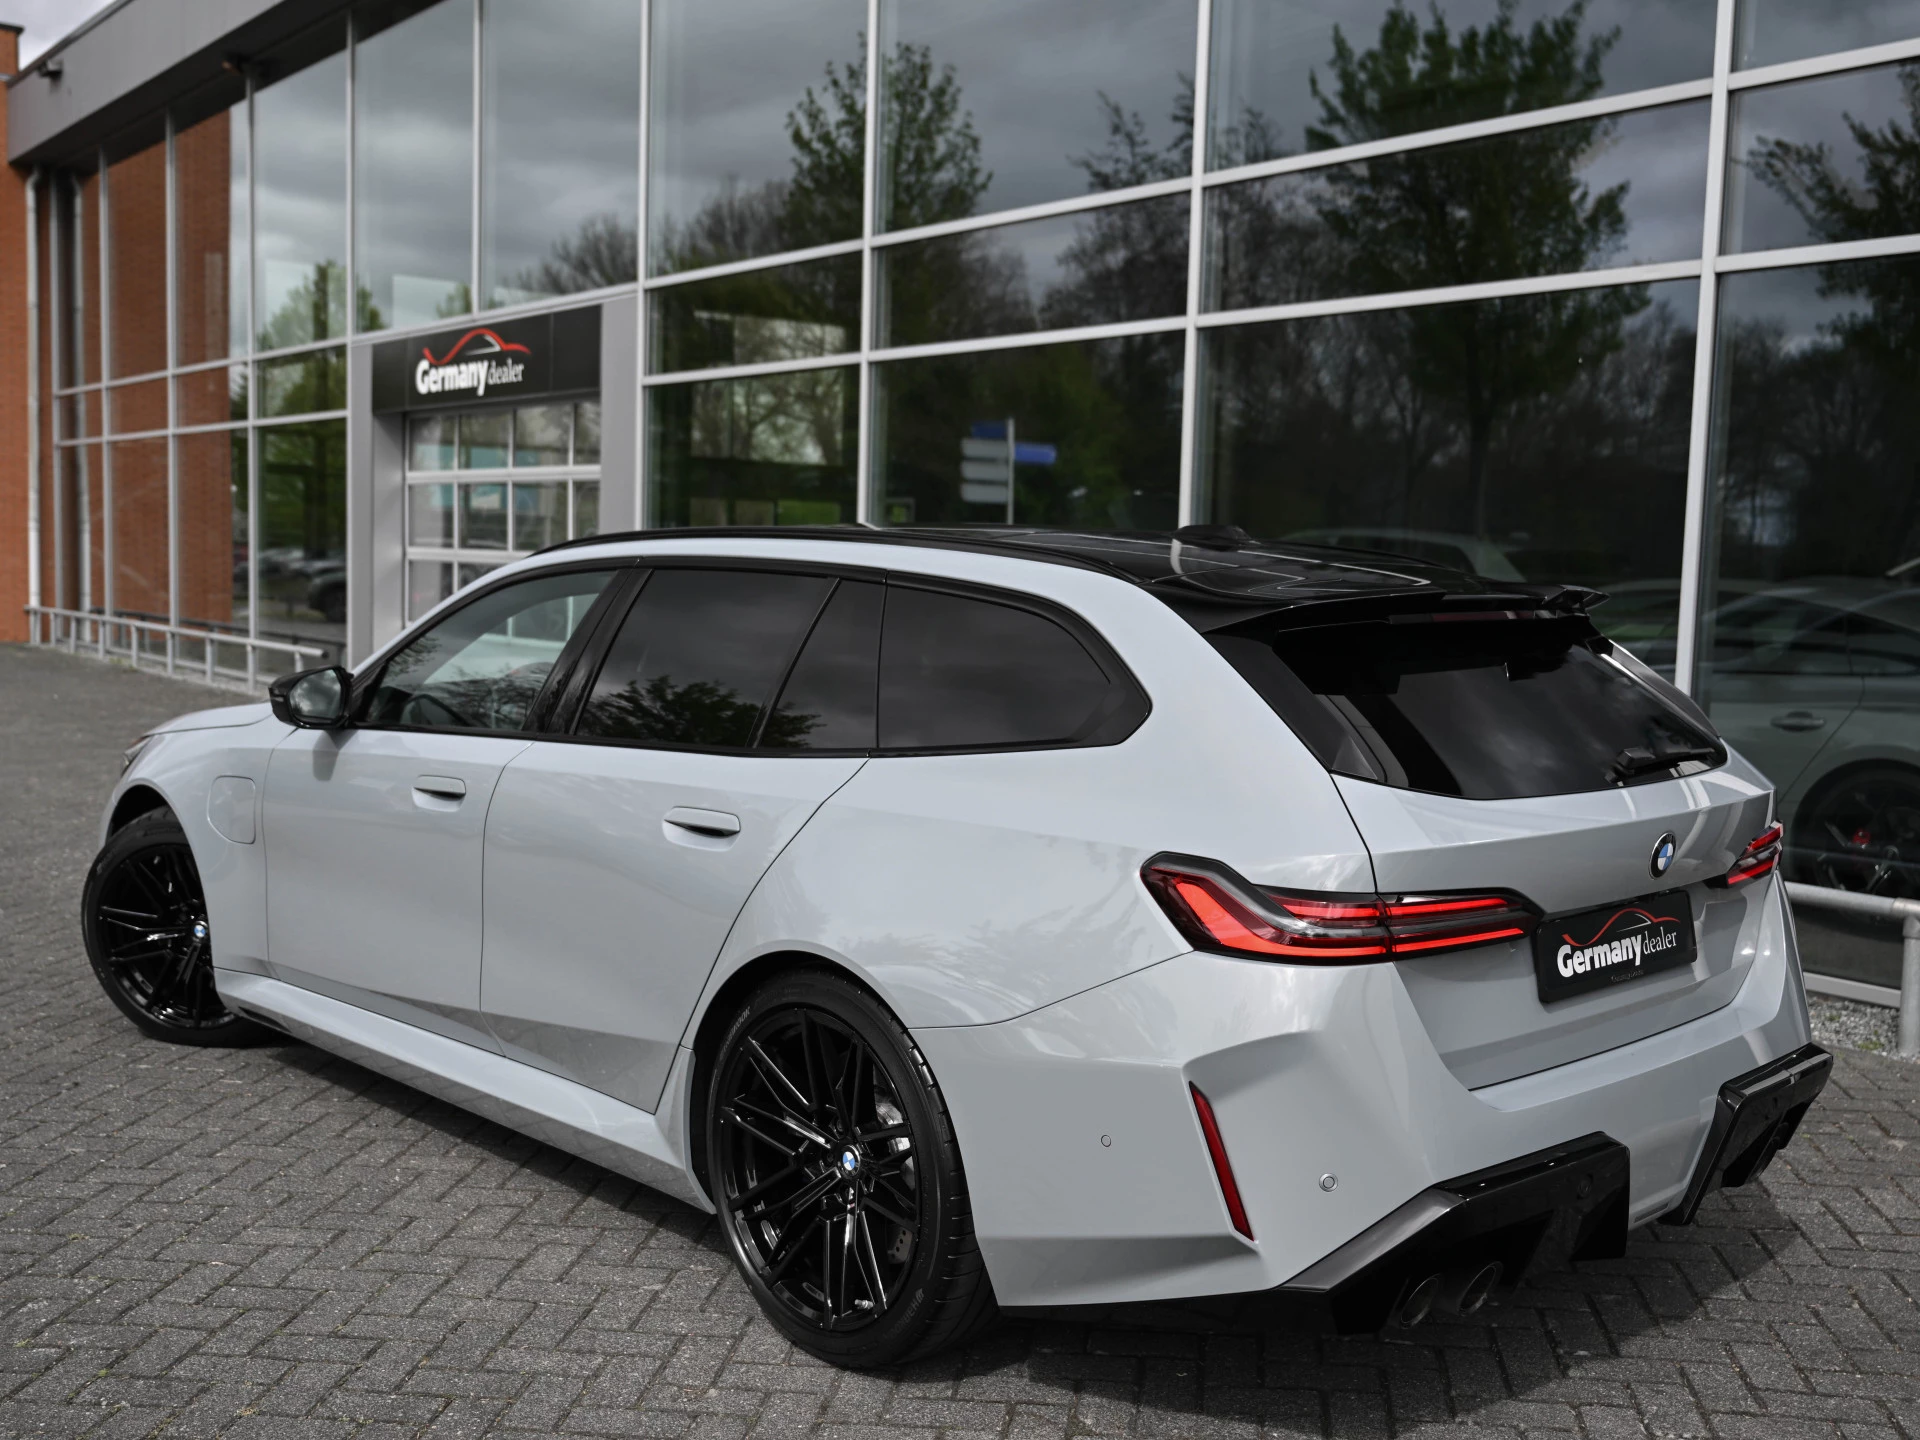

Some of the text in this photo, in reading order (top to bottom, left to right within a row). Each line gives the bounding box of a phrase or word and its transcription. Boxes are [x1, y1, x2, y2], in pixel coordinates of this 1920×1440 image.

[415, 357, 524, 396] Germany dealer
[1557, 926, 1677, 978] Germany dealer
